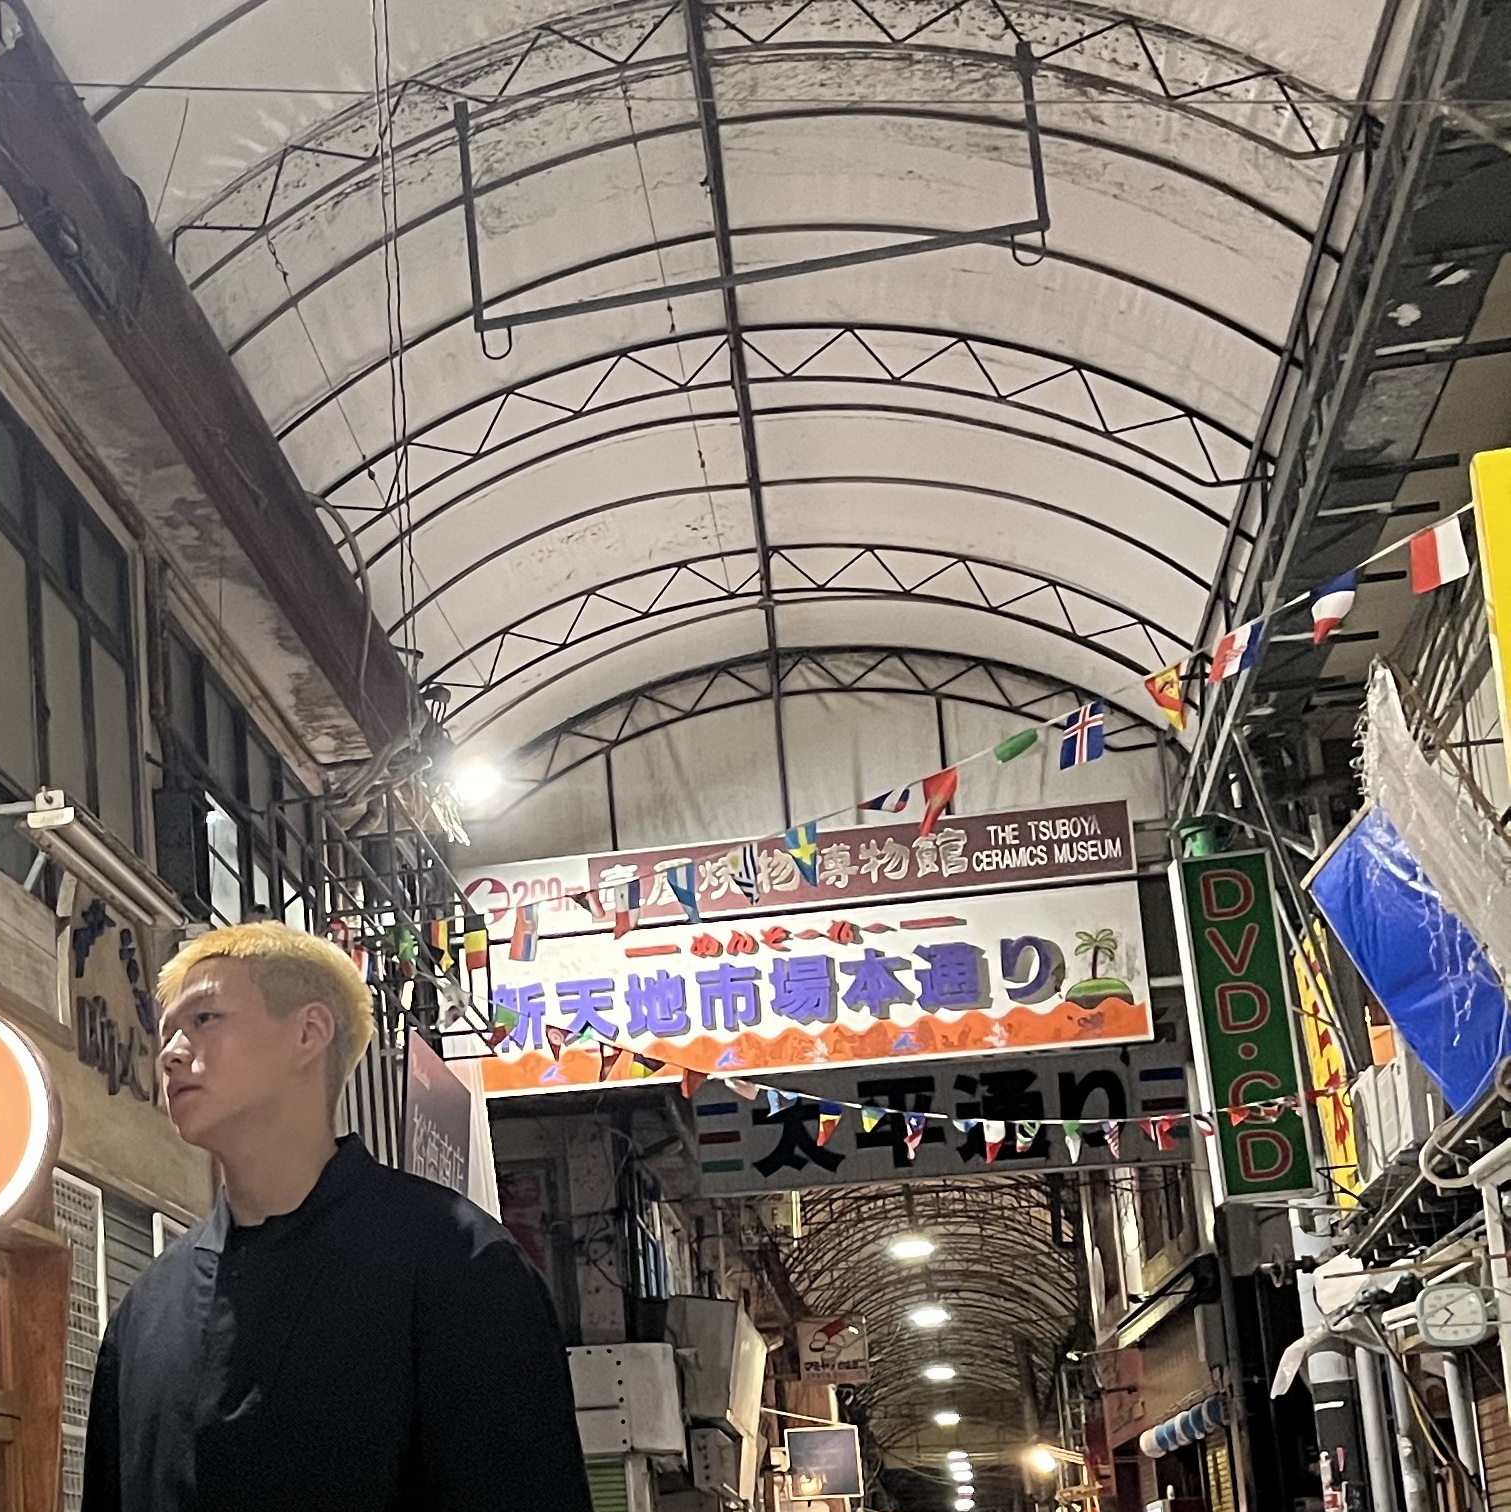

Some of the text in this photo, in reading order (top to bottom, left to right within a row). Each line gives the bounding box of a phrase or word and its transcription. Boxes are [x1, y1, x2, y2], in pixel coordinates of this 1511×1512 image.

[972, 837, 1123, 873] CERAMICS MUSEUM
[987, 814, 1102, 846] THE TSUBOYA
[490, 935, 1063, 1053] 新天地市場本通り
[752, 1067, 1128, 1178] 太平通り
